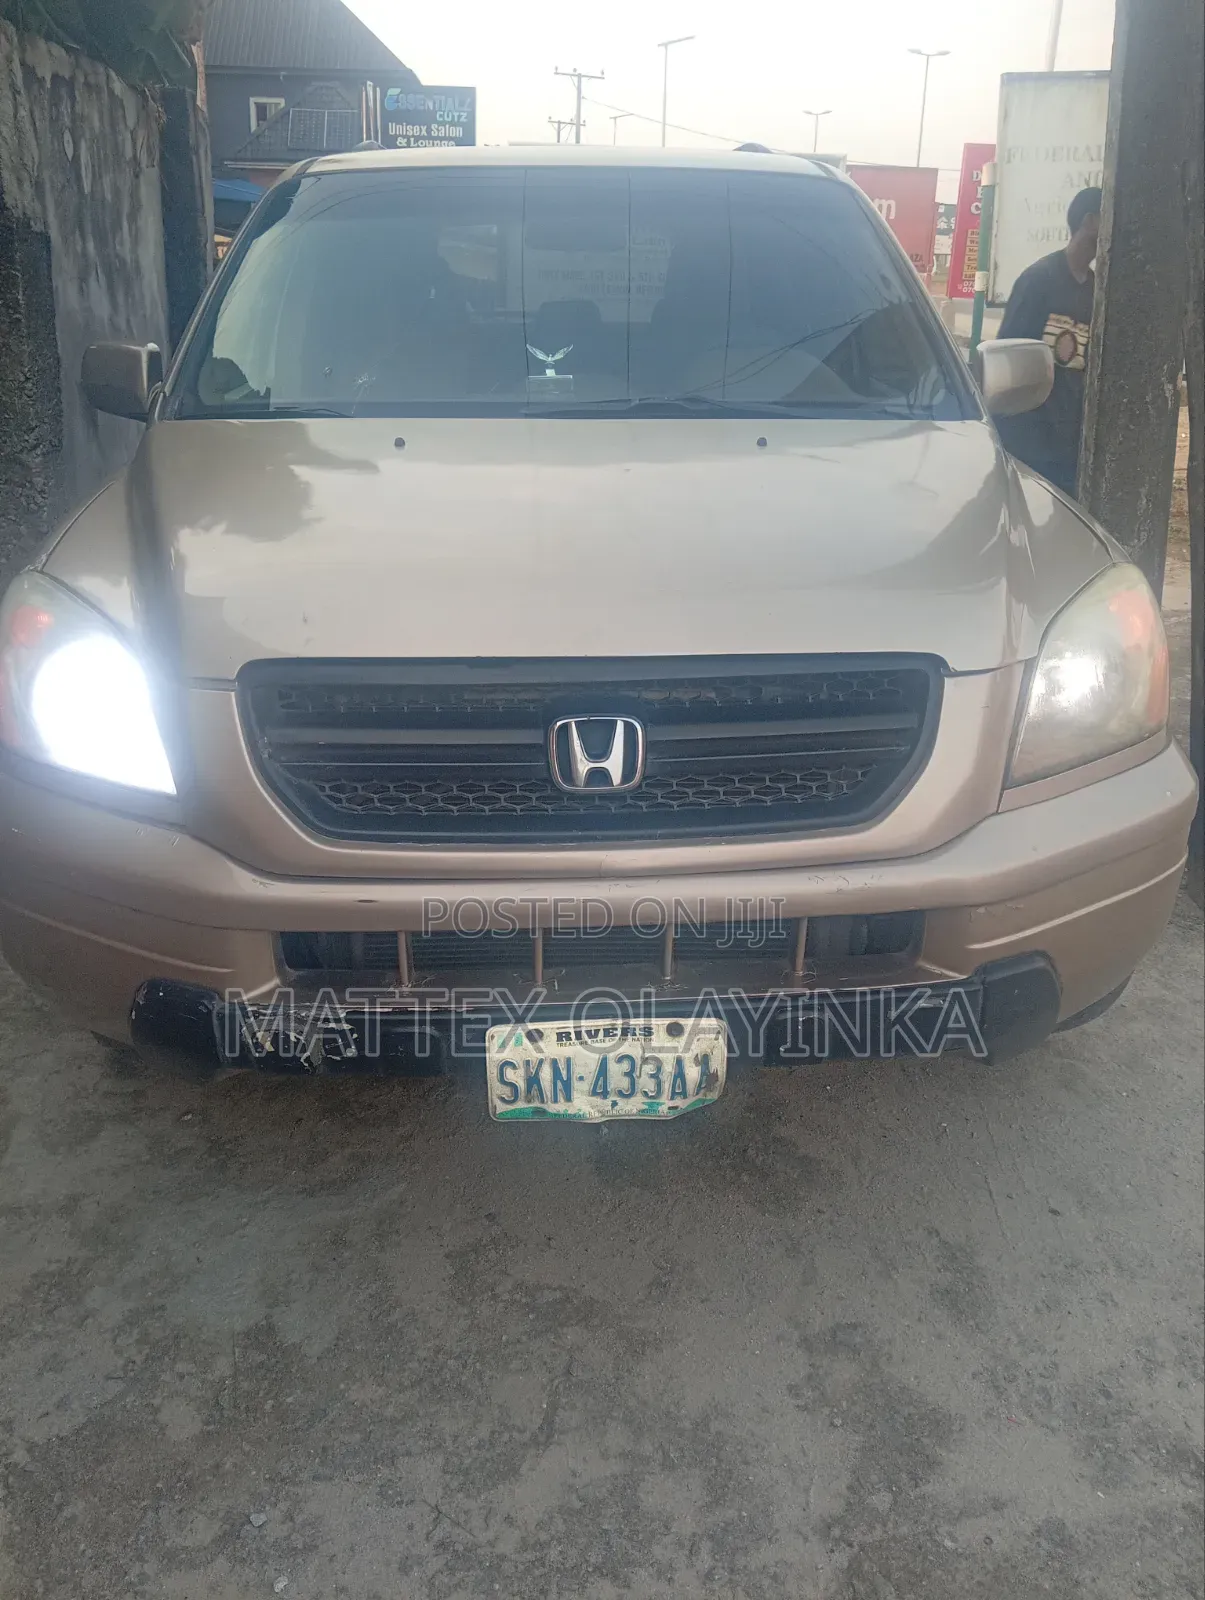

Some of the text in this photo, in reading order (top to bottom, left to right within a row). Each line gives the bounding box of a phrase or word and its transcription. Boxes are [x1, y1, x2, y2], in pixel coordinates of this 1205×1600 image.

[436, 111, 468, 122] CUTZ
[388, 122, 463, 138] Unisex Salon
[396, 137, 456, 147] & Lounge
[556, 1026, 654, 1042] RIVERS
